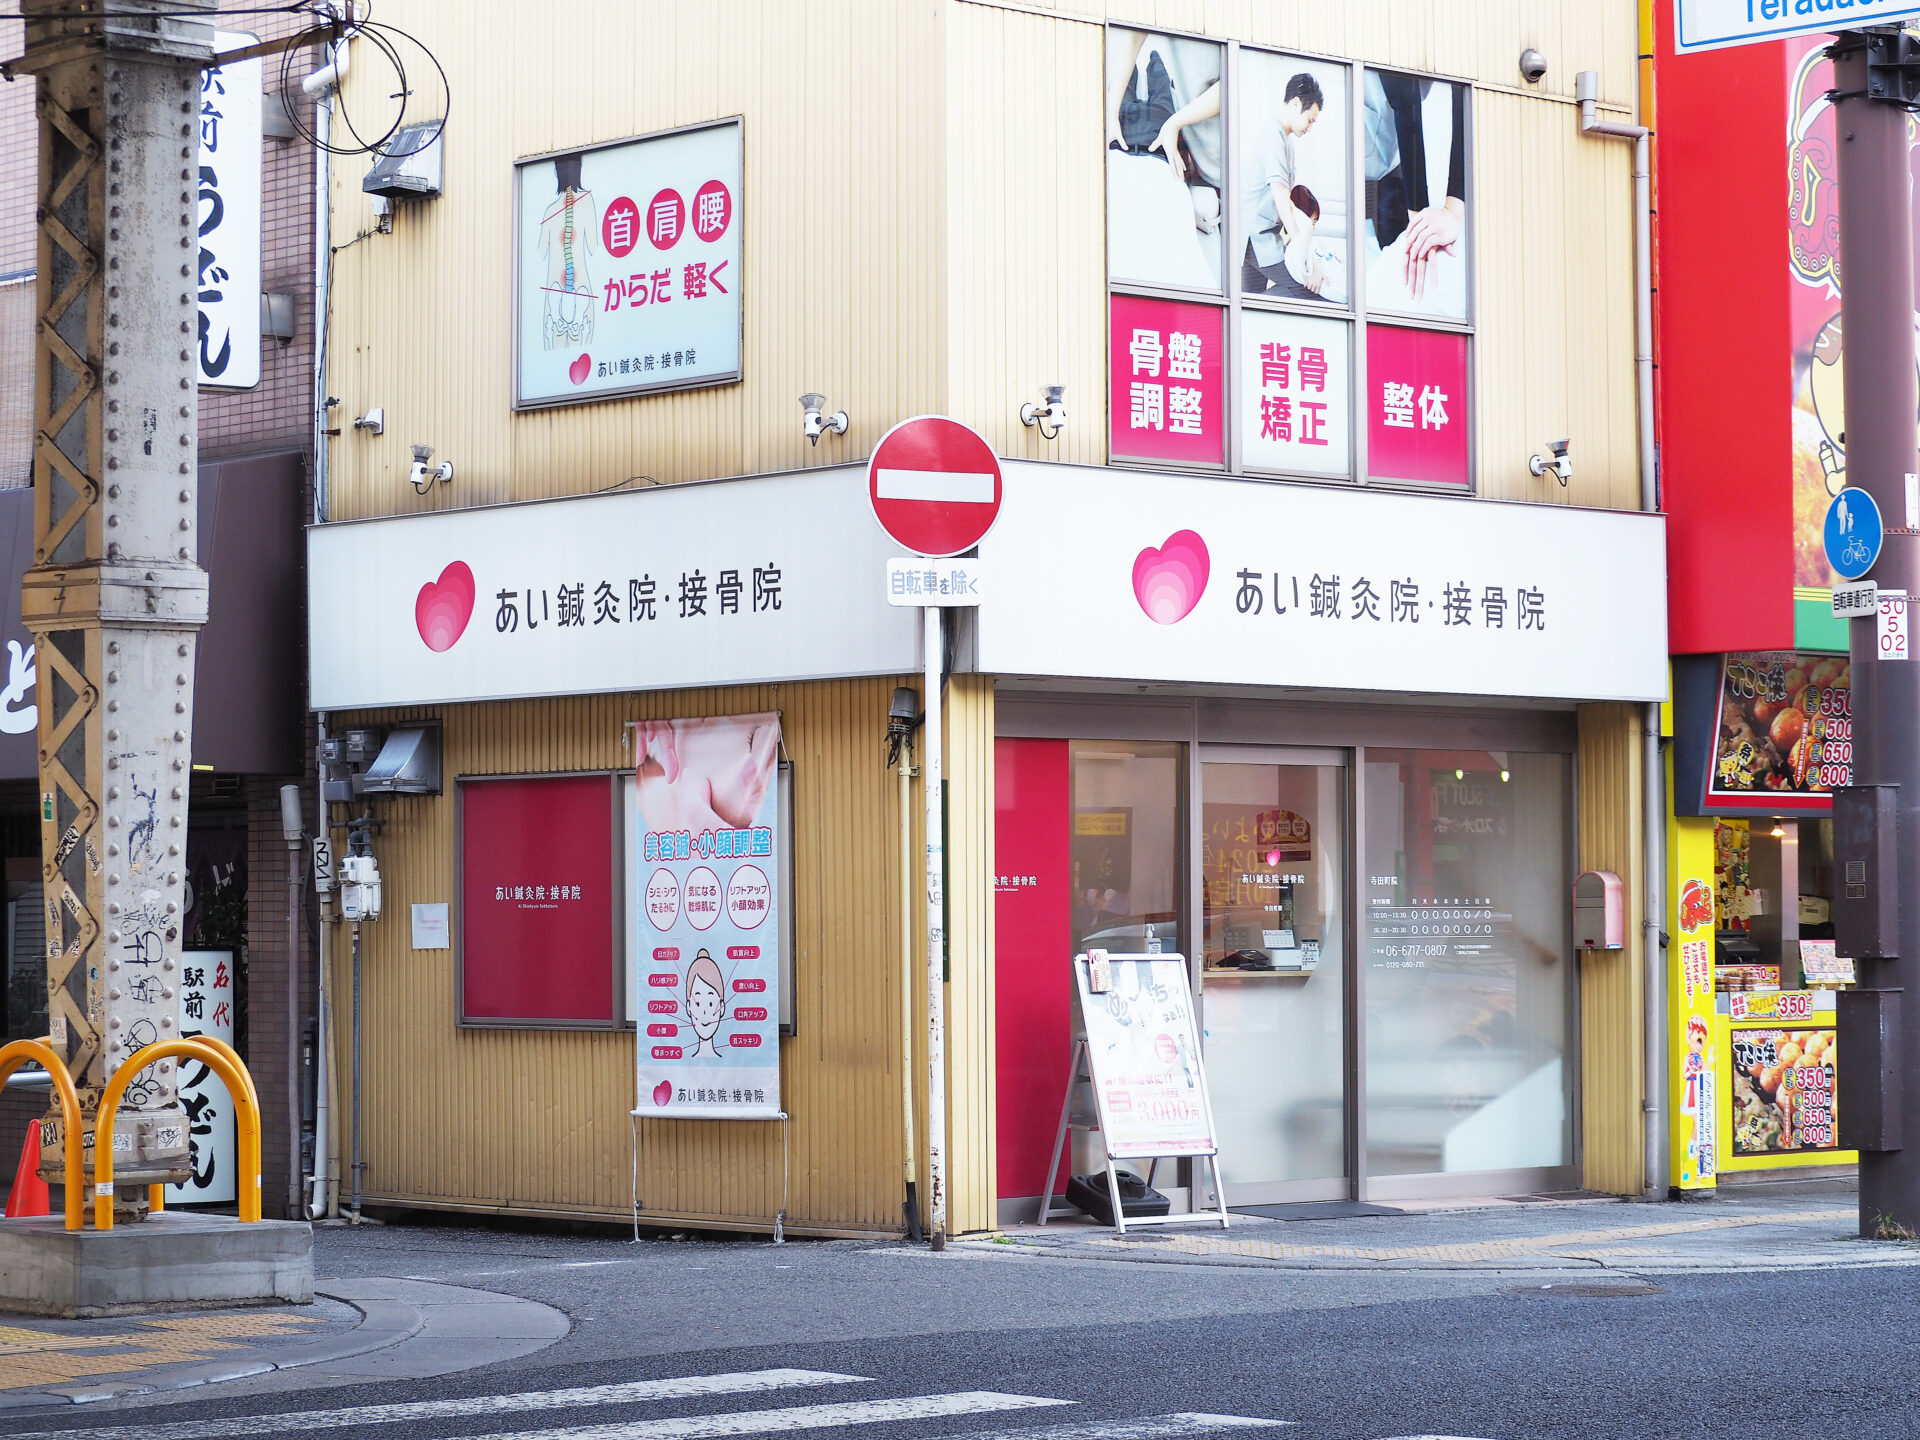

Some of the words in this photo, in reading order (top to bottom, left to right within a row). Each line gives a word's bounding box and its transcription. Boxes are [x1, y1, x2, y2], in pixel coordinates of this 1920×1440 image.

[608, 207, 634, 250] 首
[652, 199, 679, 243] 肩
[698, 190, 725, 234] 腰
[603, 267, 672, 312] からだ
[683, 260, 729, 300] 軽く
[1129, 328, 1202, 381] 骨盤
[1259, 342, 1328, 393] 背骨
[1129, 381, 1202, 435] 調整
[1259, 394, 1329, 446] 矯正
[1383, 381, 1449, 431] 整体
[495, 561, 782, 633] あい鍼灸院・接骨院
[891, 569, 978, 595] 自転車を除く
[1235, 567, 1545, 631] あい鍼灸院・接骨院
[1880, 598, 1905, 614] 30
[1888, 616, 1899, 632] 5
[1881, 634, 1905, 651] 02
[645, 827, 772, 861] 美容鍼・小顔調整
[688, 886, 716, 897] 気になる
[730, 885, 767, 896] リフトアップ
[1370, 876, 1398, 886] 寺田町院
[651, 903, 675, 913] たるみに
[688, 901, 716, 912] 乾燥肌に
[731, 899, 765, 911] 小顔効果
[1385, 945, 1448, 957] 06-6717-0807
[213, 961, 230, 1027] 名代
